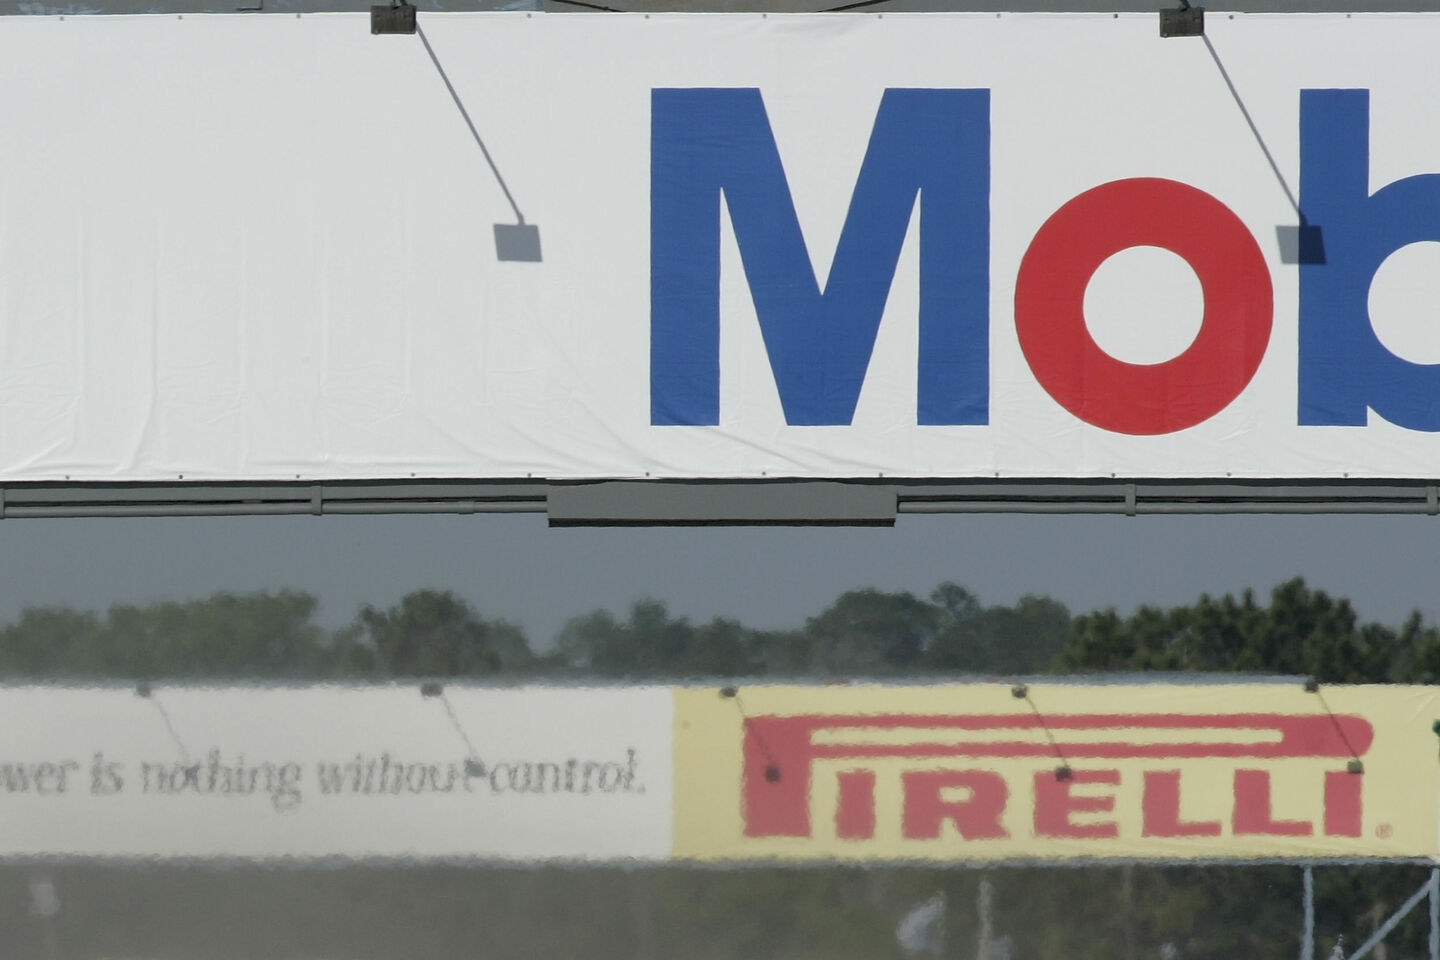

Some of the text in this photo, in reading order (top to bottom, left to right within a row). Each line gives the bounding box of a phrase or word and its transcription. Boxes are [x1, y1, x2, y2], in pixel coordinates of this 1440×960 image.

[90, 752, 124, 794] is
[141, 748, 302, 812] nothing
[316, 750, 484, 794] without
[743, 713, 1374, 839] PIRELLI
